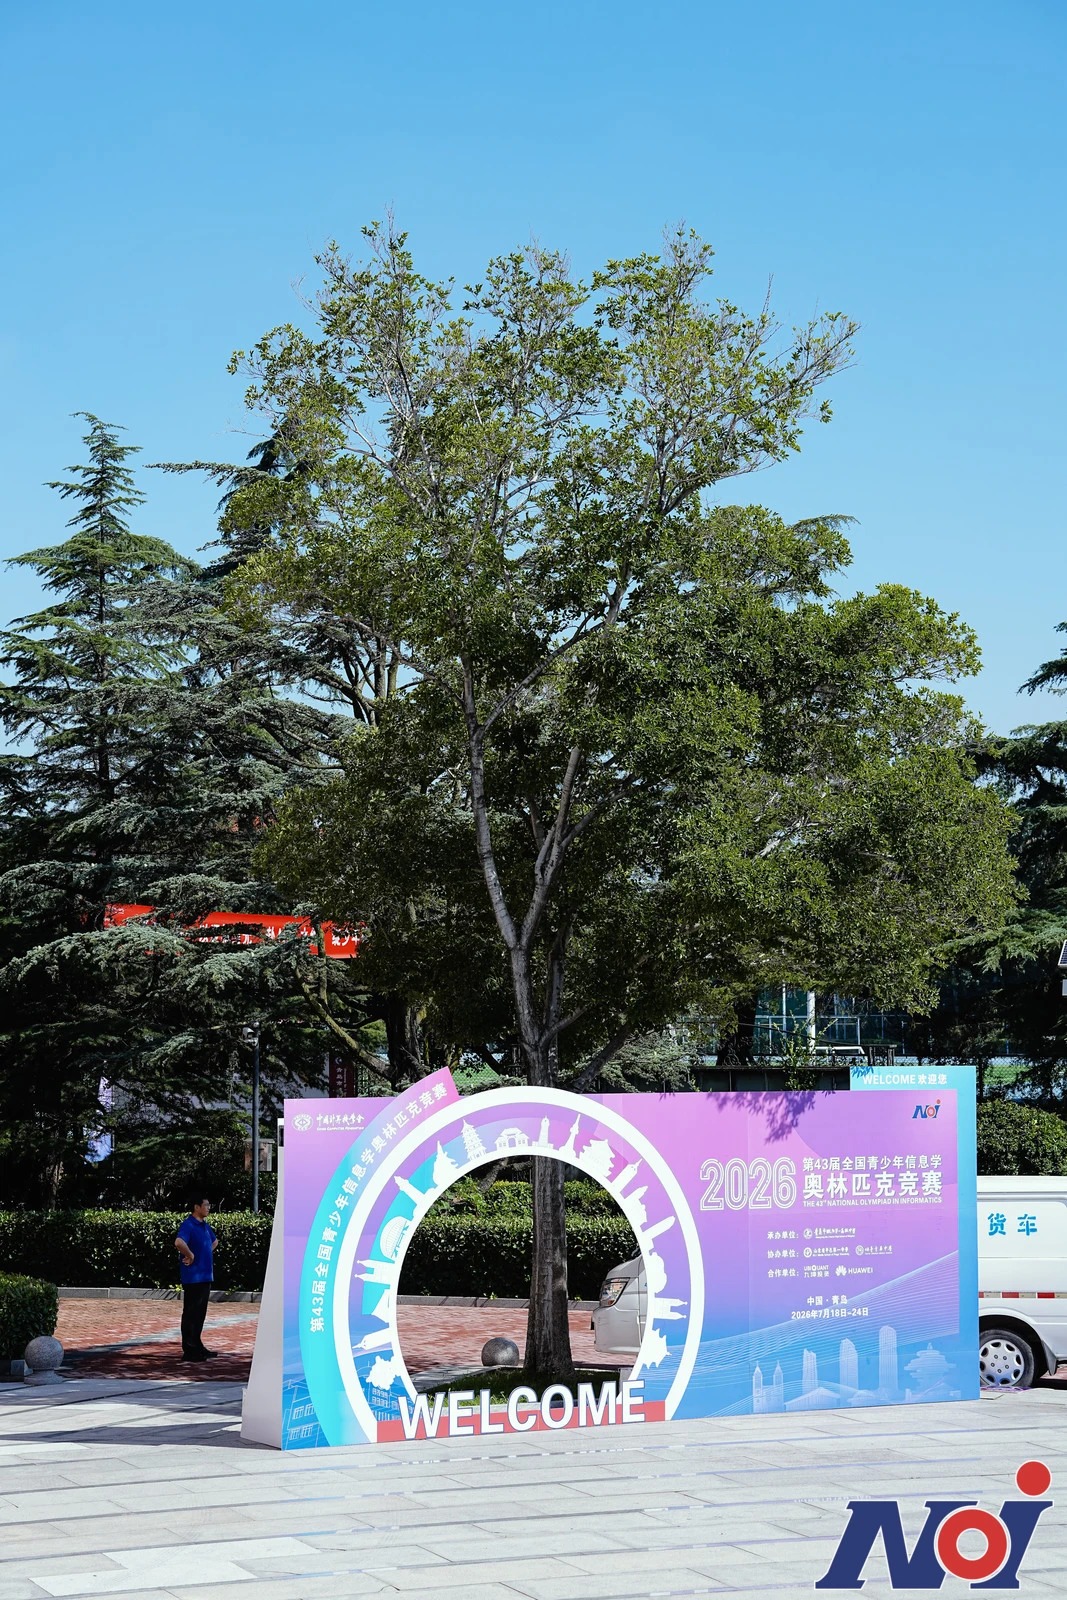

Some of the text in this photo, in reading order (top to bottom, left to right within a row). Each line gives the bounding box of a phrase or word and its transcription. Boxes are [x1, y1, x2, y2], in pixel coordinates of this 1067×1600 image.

[862, 1073, 948, 1085] WELCOME 欢迎您
[803, 1154, 943, 1172] 第43届全国青少年信息学
[700, 1157, 797, 1211] 2026
[803, 1170, 943, 1200] 奥林匹克竞赛
[310, 1082, 448, 1333] 第43届全国青少年信息学奥林匹克竞赛
[860, 1198, 892, 1206] OLYMPIAD
[900, 1196, 943, 1204] INFORMATICS
[848, 1266, 874, 1275] HUAWEI
[398, 1379, 646, 1440] WELCOME
